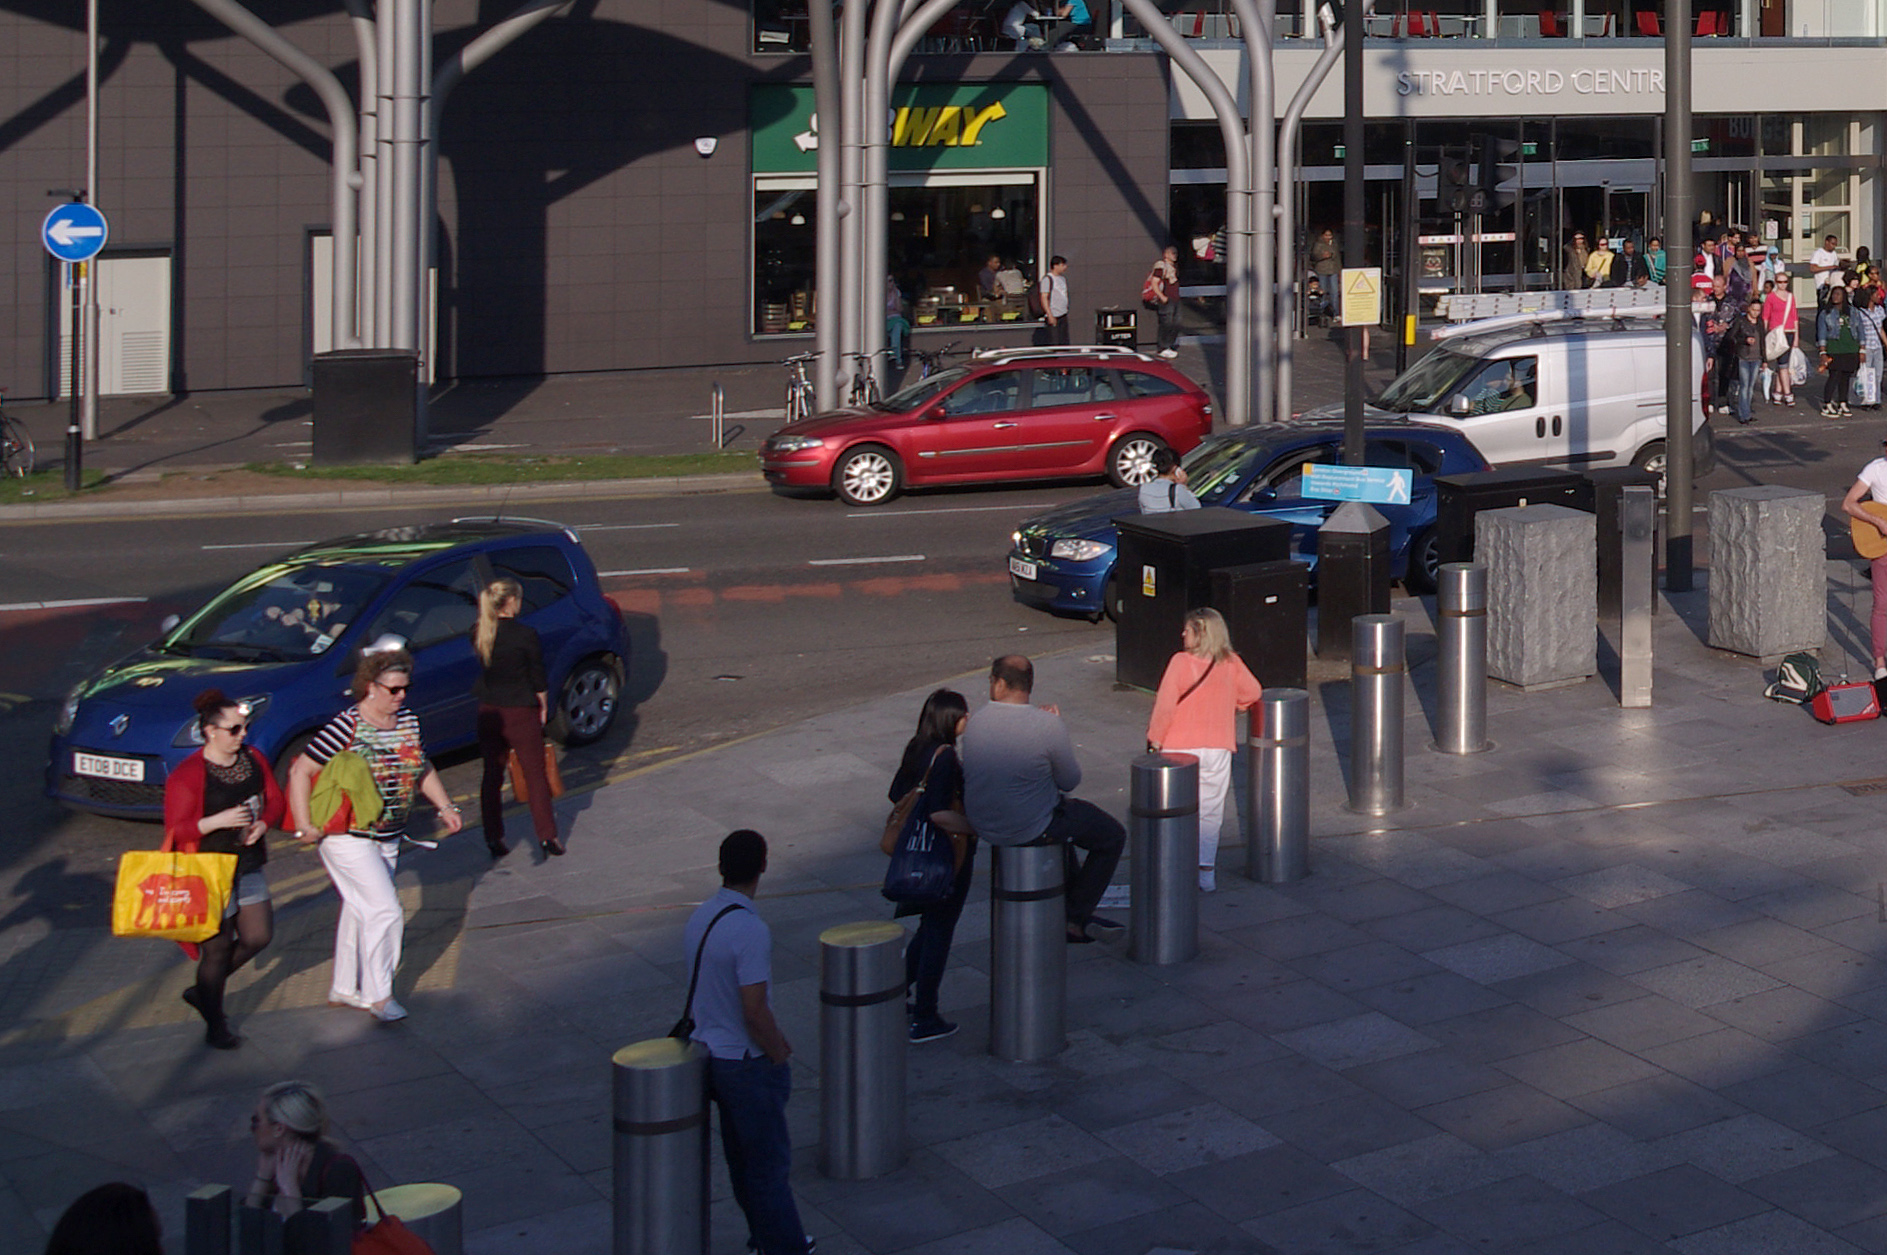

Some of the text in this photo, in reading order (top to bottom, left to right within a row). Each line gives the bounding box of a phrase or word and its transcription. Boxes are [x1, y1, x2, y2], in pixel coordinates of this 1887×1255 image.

[1396, 69, 1666, 95] STRATFORD CENTR
[81, 756, 138, 777] ET08 DCE
